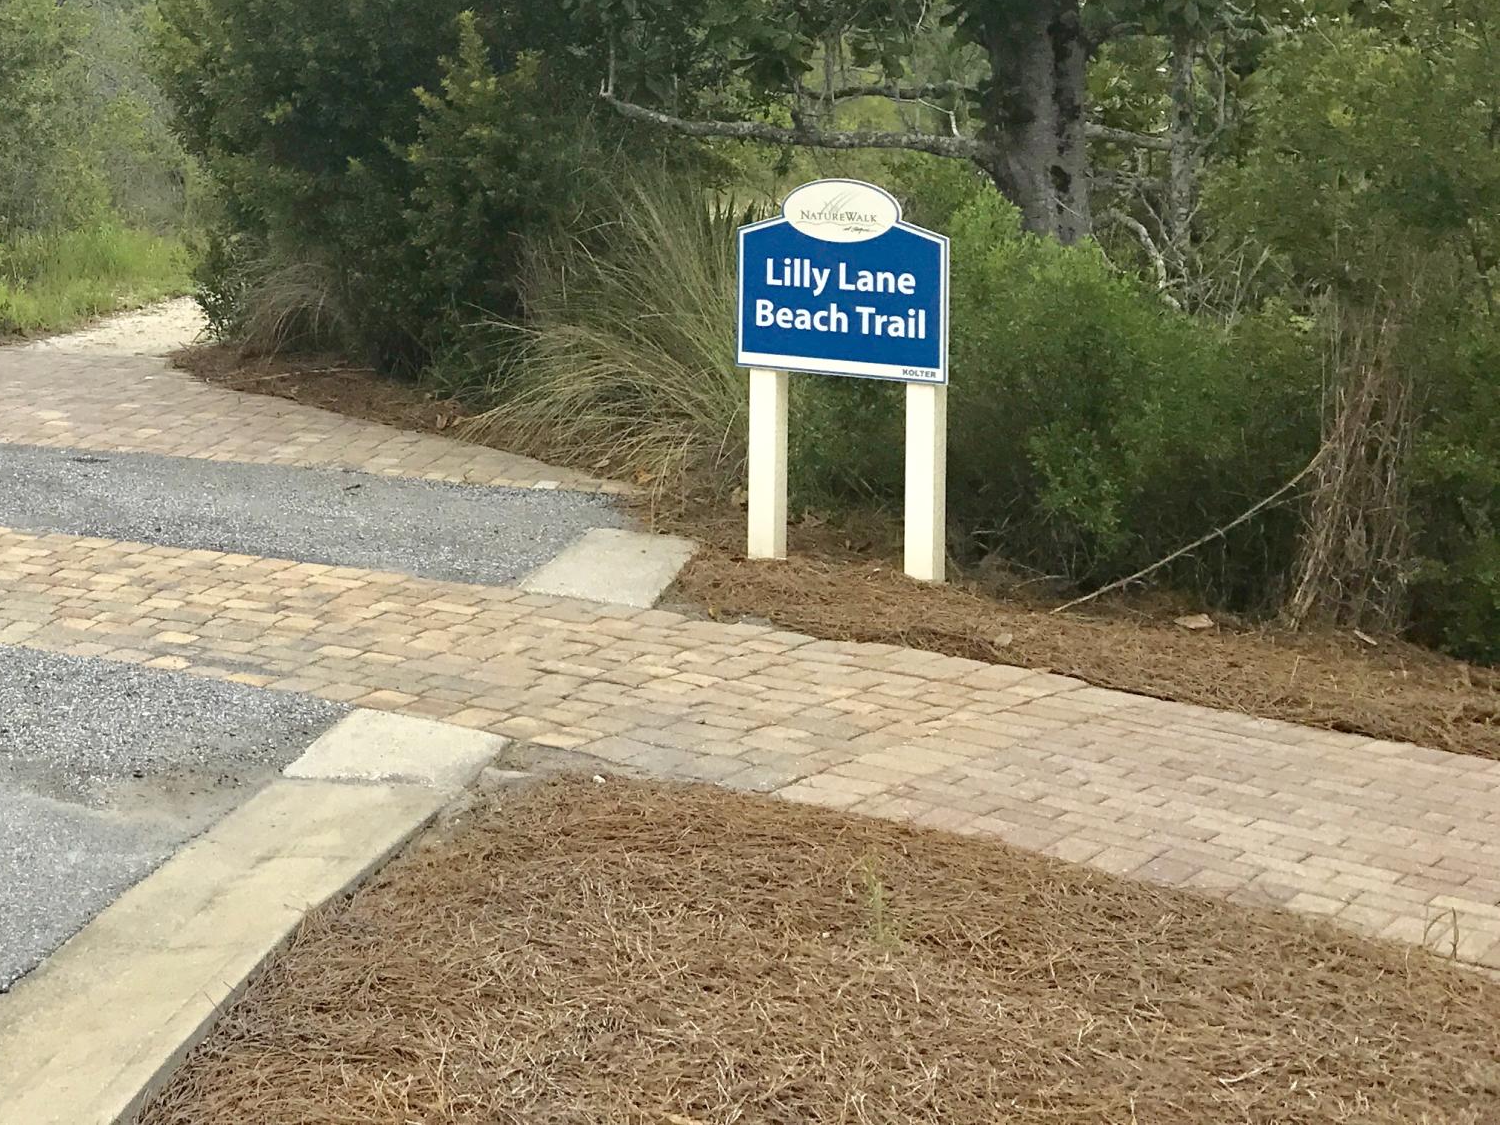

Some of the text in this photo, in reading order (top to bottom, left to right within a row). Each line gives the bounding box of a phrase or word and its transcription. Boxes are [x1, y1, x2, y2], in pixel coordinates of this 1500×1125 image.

[766, 258, 916, 297] Lilly Lane
[755, 299, 926, 339] Beach Trail
[902, 368, 937, 378] KOLTER
